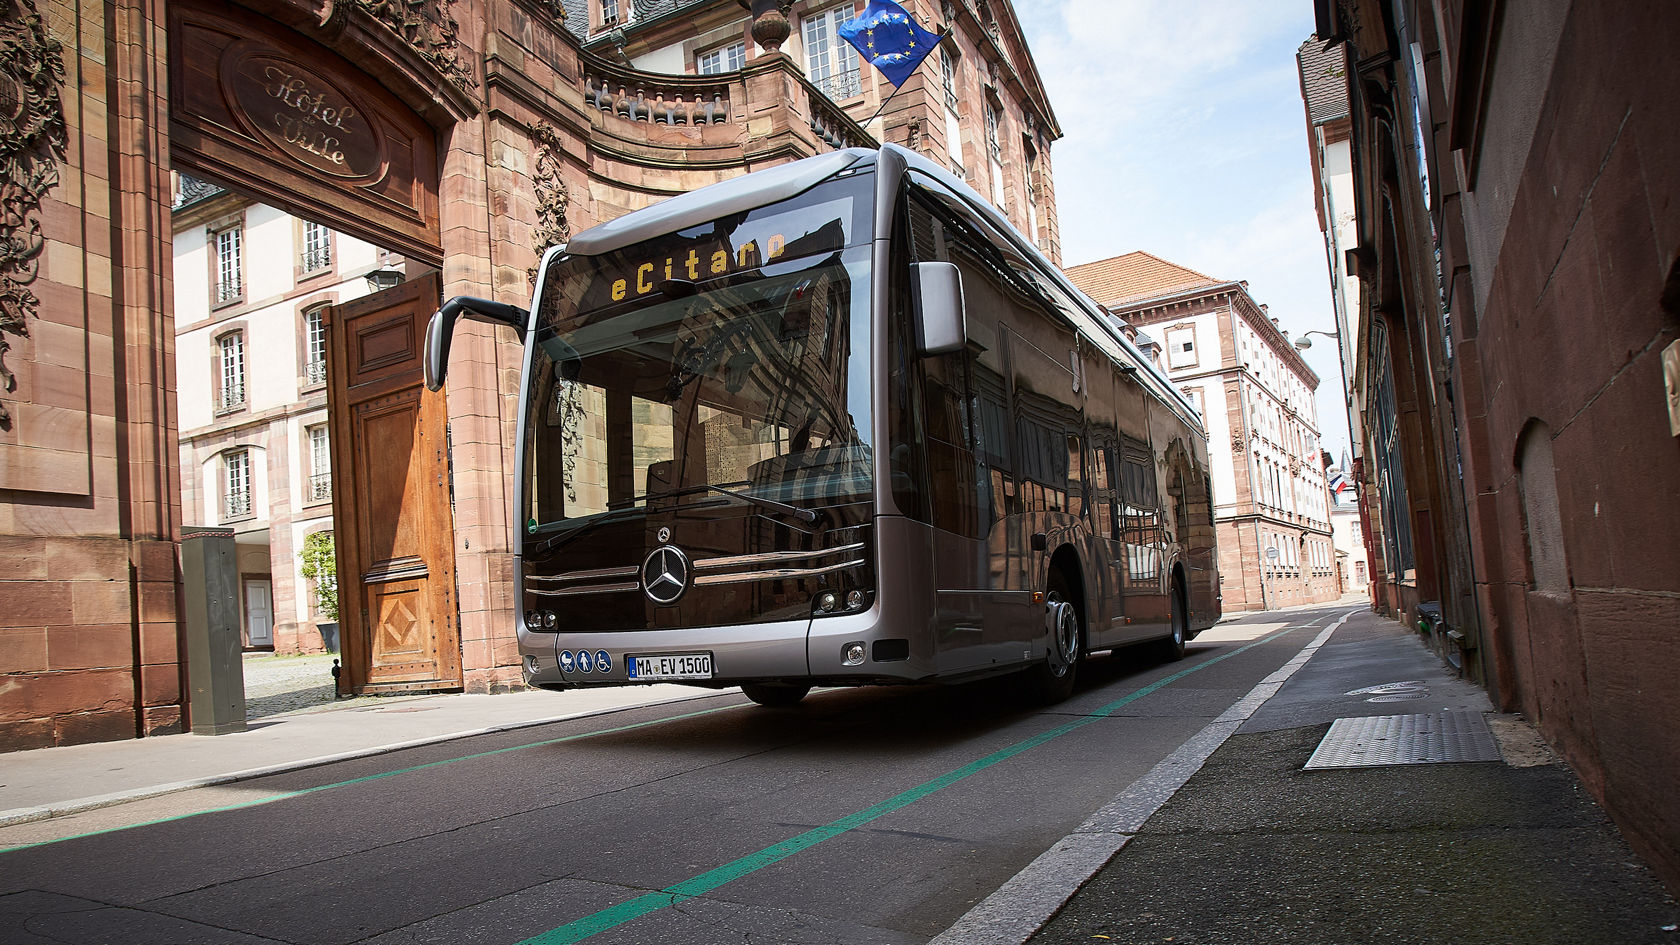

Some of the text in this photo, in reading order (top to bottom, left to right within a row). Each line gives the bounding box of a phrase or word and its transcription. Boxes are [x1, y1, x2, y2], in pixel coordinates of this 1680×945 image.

[275, 112, 344, 165] Ville
[611, 233, 785, 301] eCitaro
[637, 659, 652, 675] MA
[660, 658, 675, 674] EV
[679, 657, 709, 674] 1500
